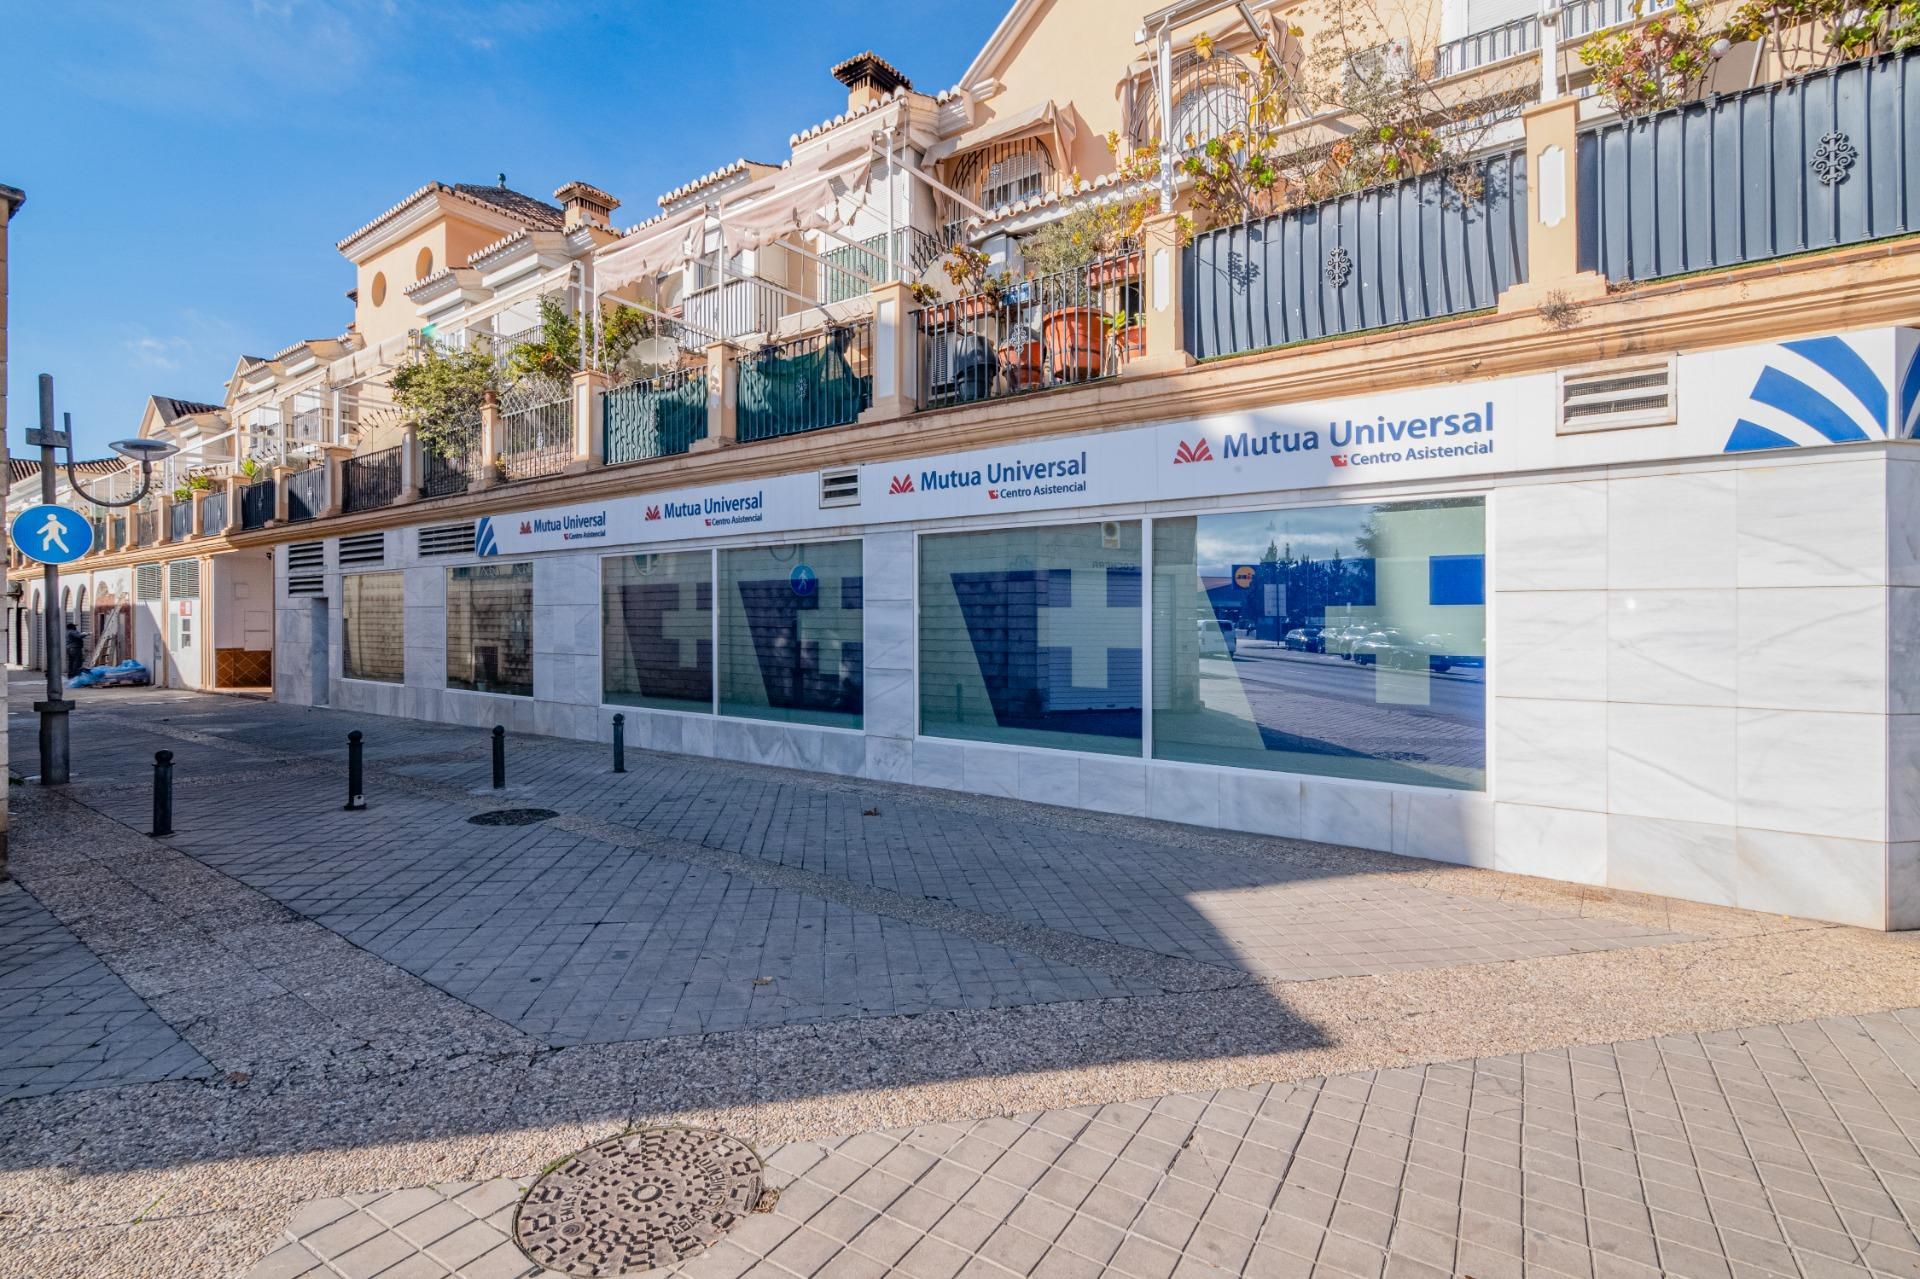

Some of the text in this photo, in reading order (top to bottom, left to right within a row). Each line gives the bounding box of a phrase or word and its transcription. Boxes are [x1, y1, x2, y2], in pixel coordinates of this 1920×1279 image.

[1223, 401, 1495, 459] Mutua Universal
[1350, 439, 1495, 467] Centro Asistencial
[921, 451, 1087, 491] Mutua Universal
[1000, 481, 1087, 499] Centro Asistencial
[664, 491, 763, 519] Mutua Universal
[534, 510, 606, 533] Mutua Universal
[712, 514, 763, 526] Centro Asistencial
